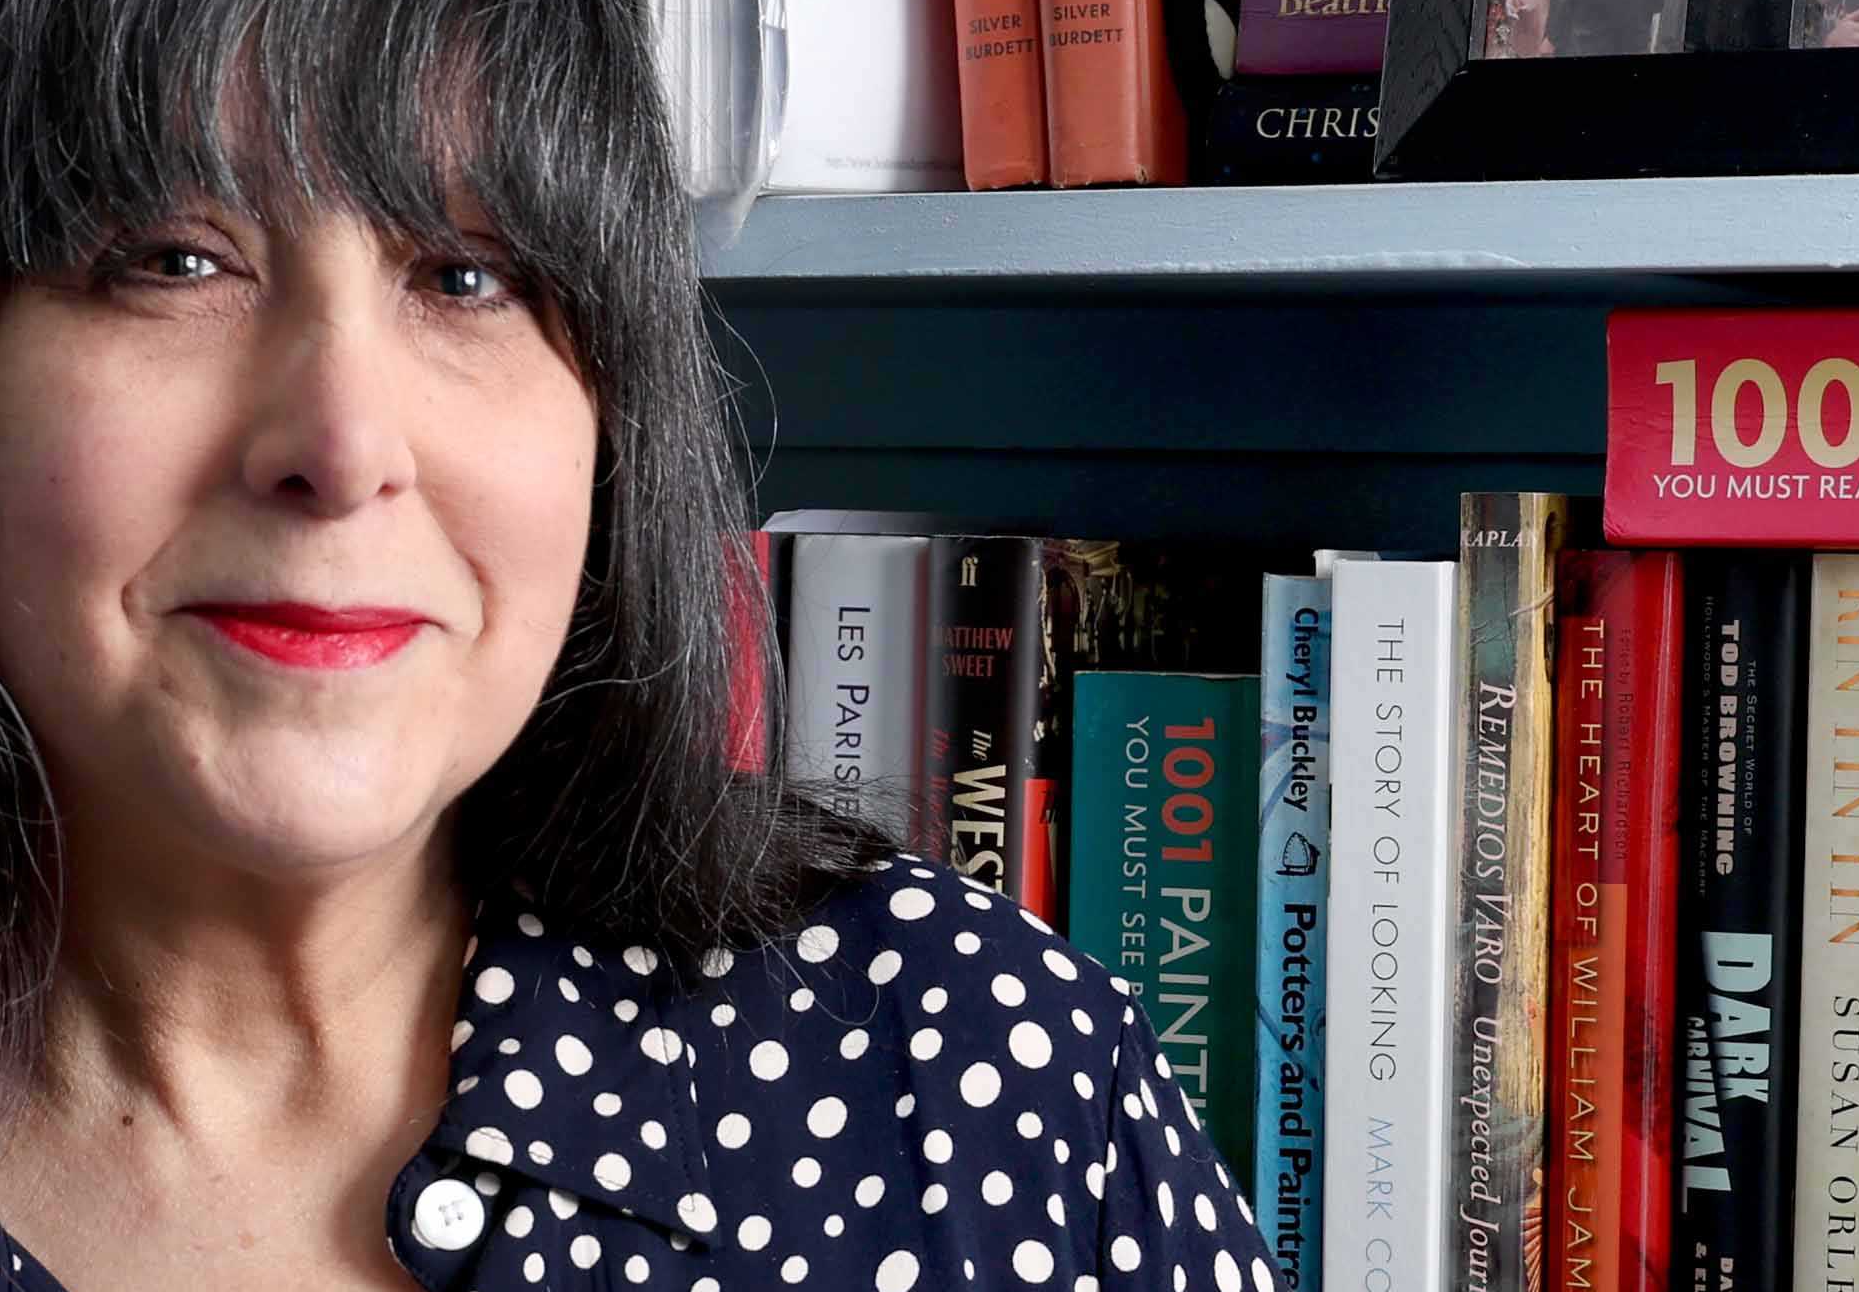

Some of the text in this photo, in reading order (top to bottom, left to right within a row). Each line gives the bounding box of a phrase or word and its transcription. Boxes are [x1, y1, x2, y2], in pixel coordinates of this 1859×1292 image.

[1049, 26, 1124, 47] BURDETT
[1053, 2, 1111, 22] SILVER
[1653, 474, 1721, 500] YOU
[1727, 474, 1808, 499] MUST
[1376, 618, 1405, 684] THE
[1373, 704, 1403, 819] STORY
[1372, 835, 1400, 885] OF
[1368, 903, 1399, 1083] LOOKING
[1365, 1116, 1394, 1221] MARK
